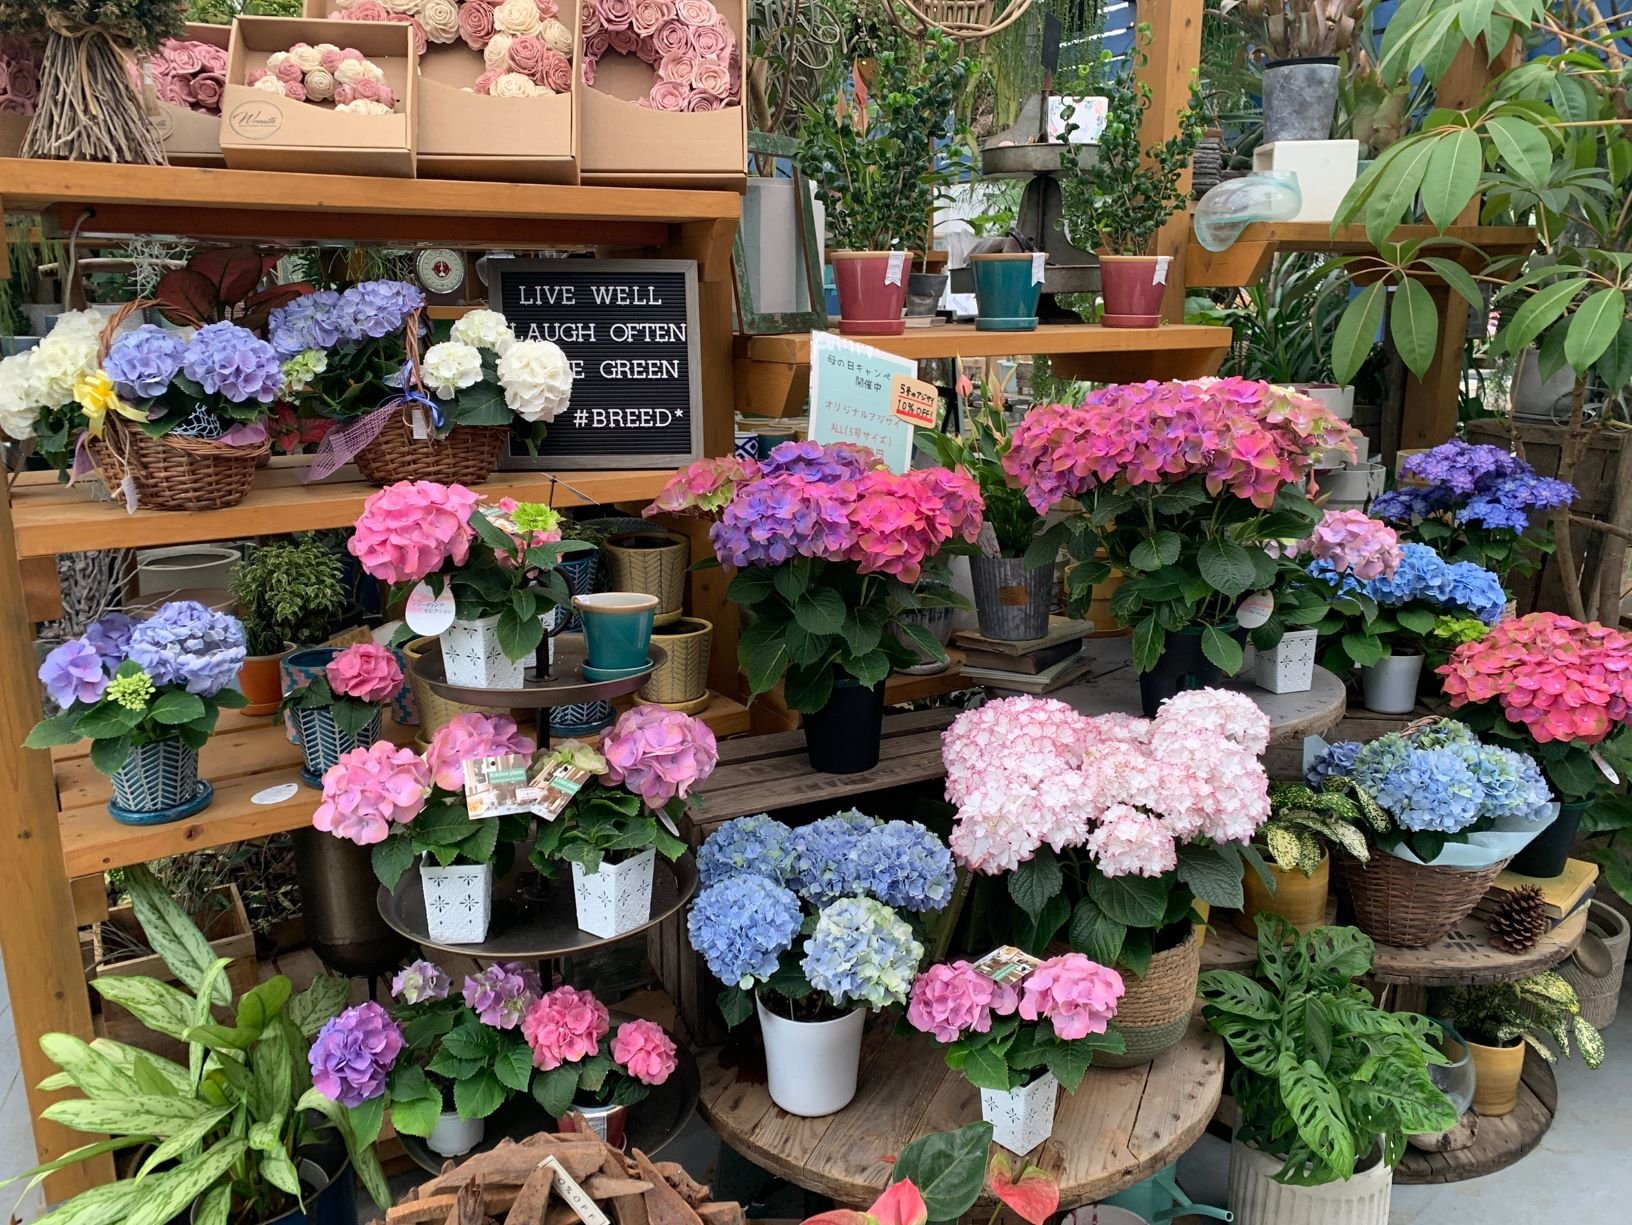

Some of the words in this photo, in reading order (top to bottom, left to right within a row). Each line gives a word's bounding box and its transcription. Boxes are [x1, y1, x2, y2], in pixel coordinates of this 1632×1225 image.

[518, 286, 576, 305] LIVE
[590, 286, 662, 305] WELL
[510, 322, 596, 342] LAUGH
[610, 323, 687, 343] OFTEN
[599, 359, 680, 380] GREEN
[827, 354, 892, 381] 母の日キャンペ
[855, 376, 882, 393] 開催中
[825, 400, 901, 429] オリジナルアジサイ
